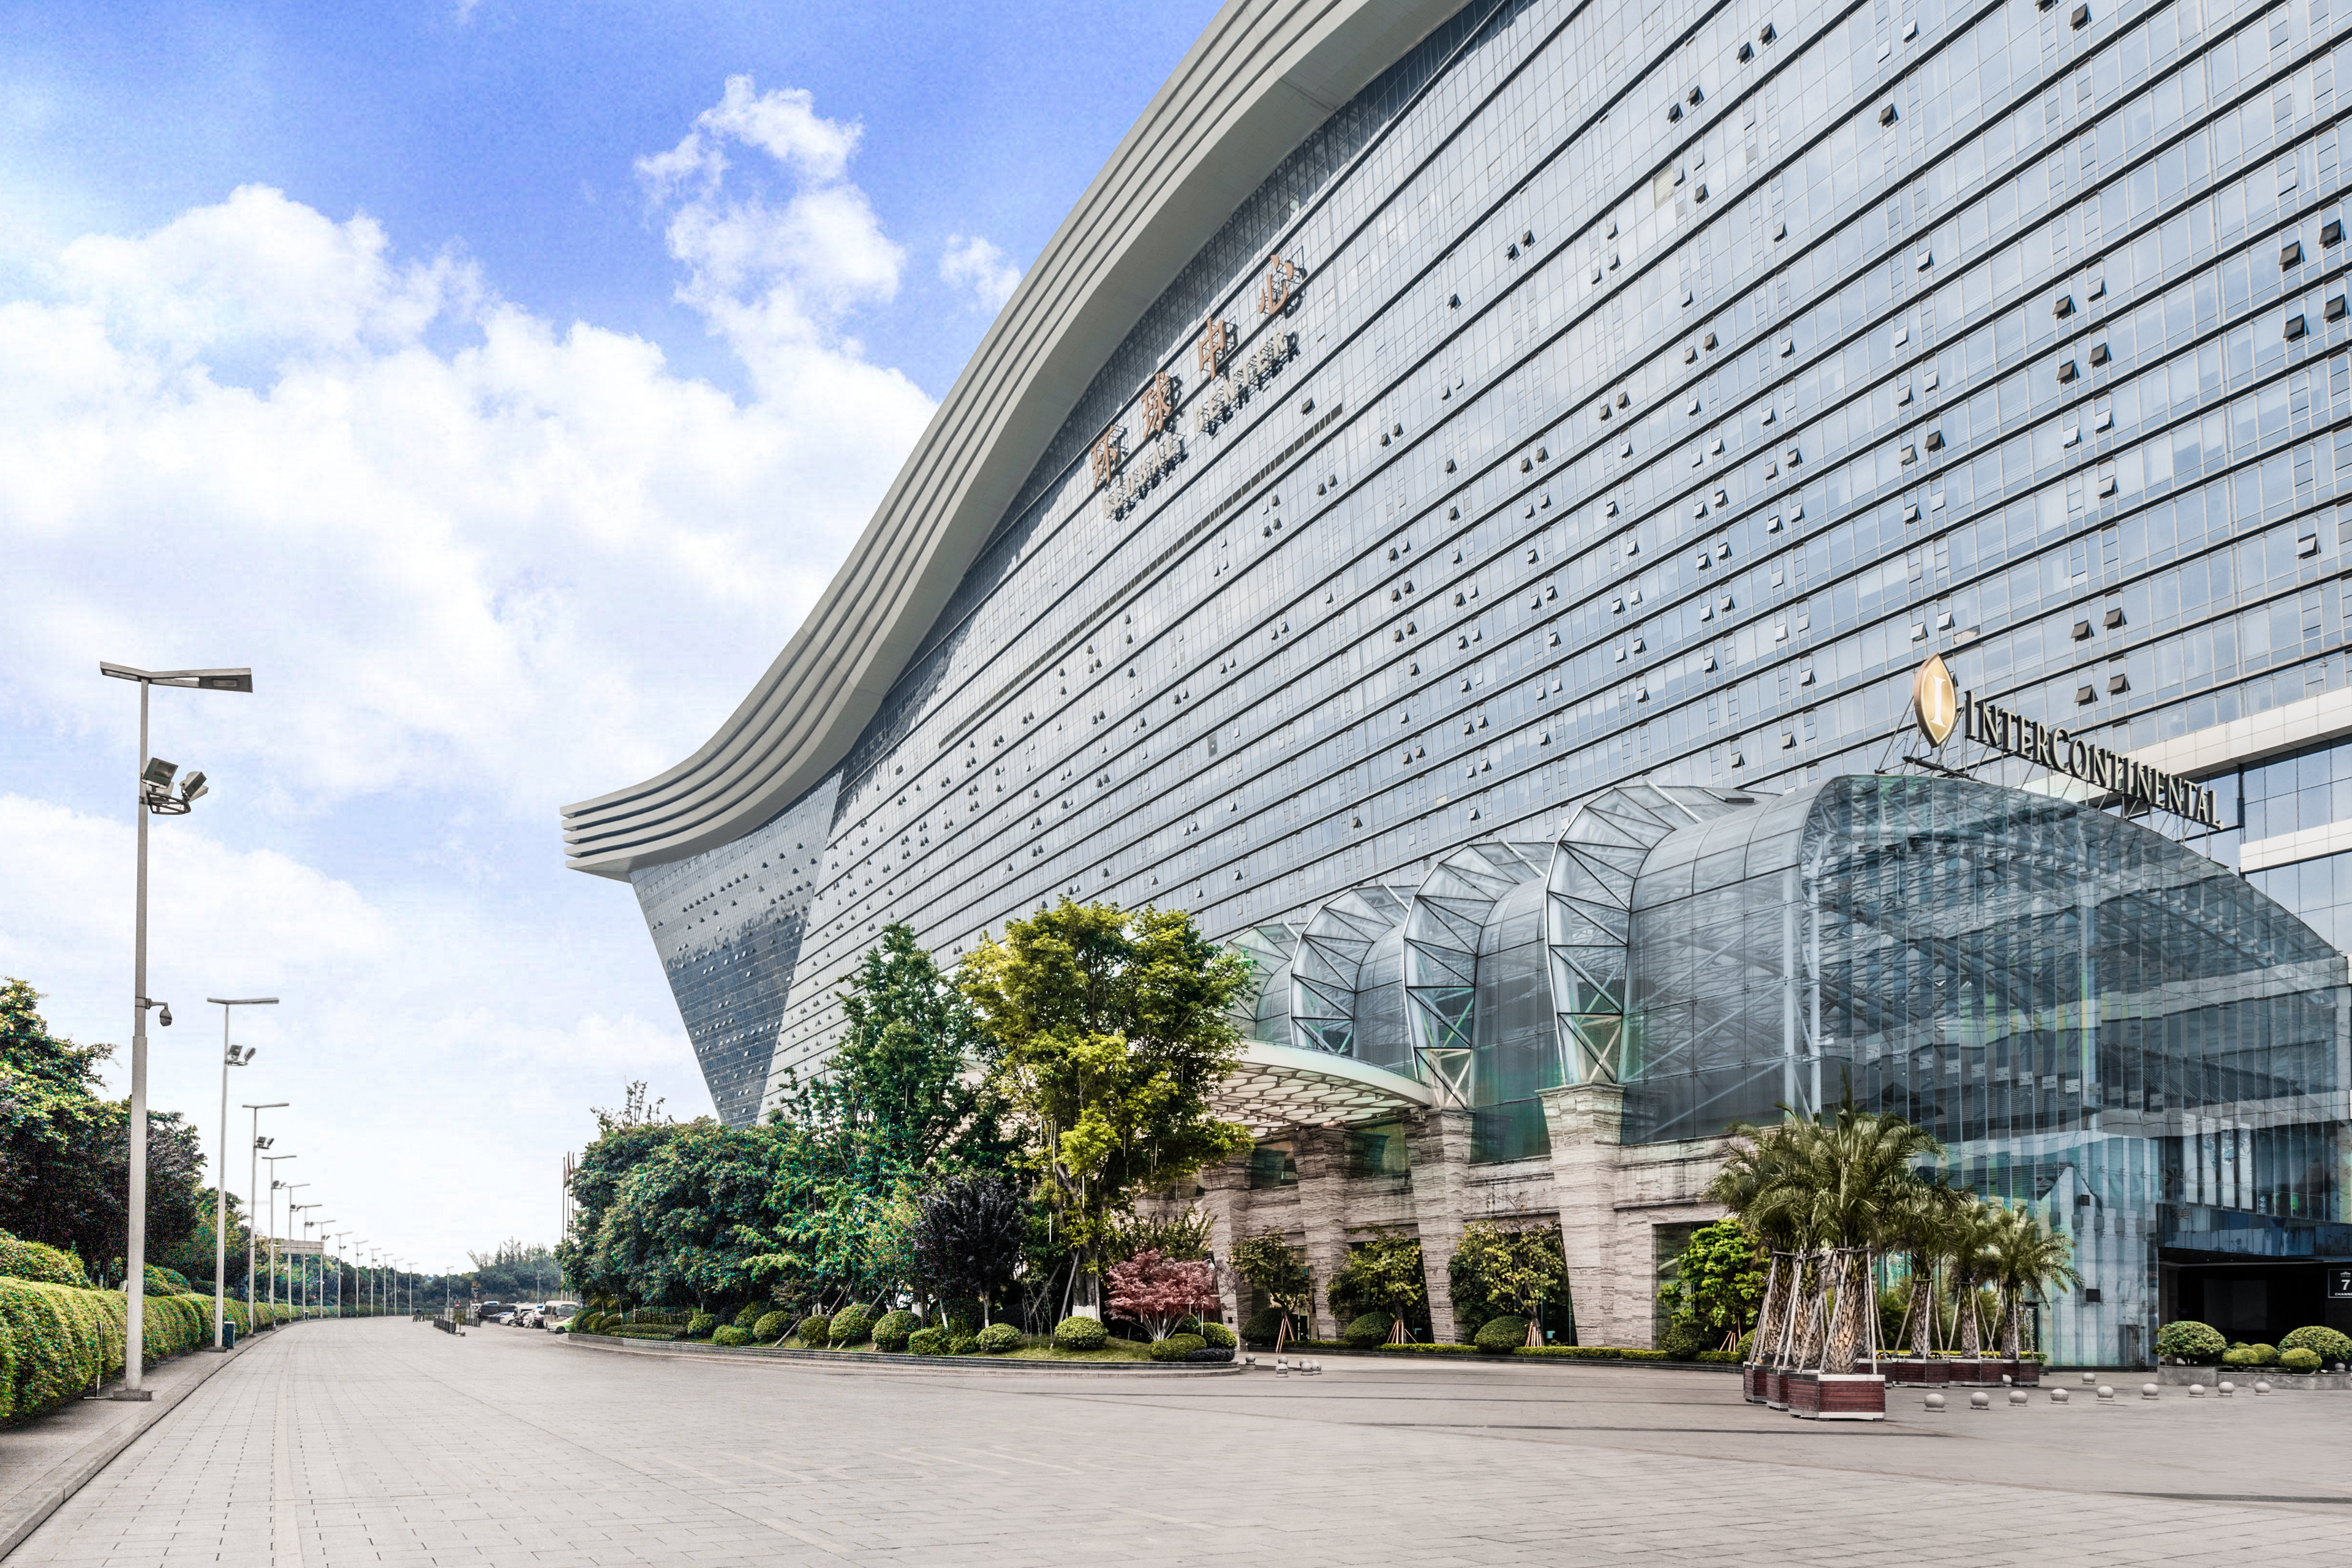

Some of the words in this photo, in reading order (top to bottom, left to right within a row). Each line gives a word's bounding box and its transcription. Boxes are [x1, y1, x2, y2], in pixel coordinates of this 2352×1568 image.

[1090, 254, 1295, 490] 环球中心
[1102, 435, 1176, 520] GLOBAL
[1194, 326, 1286, 433] CENTER
[2341, 1279, 2351, 1291] 7
